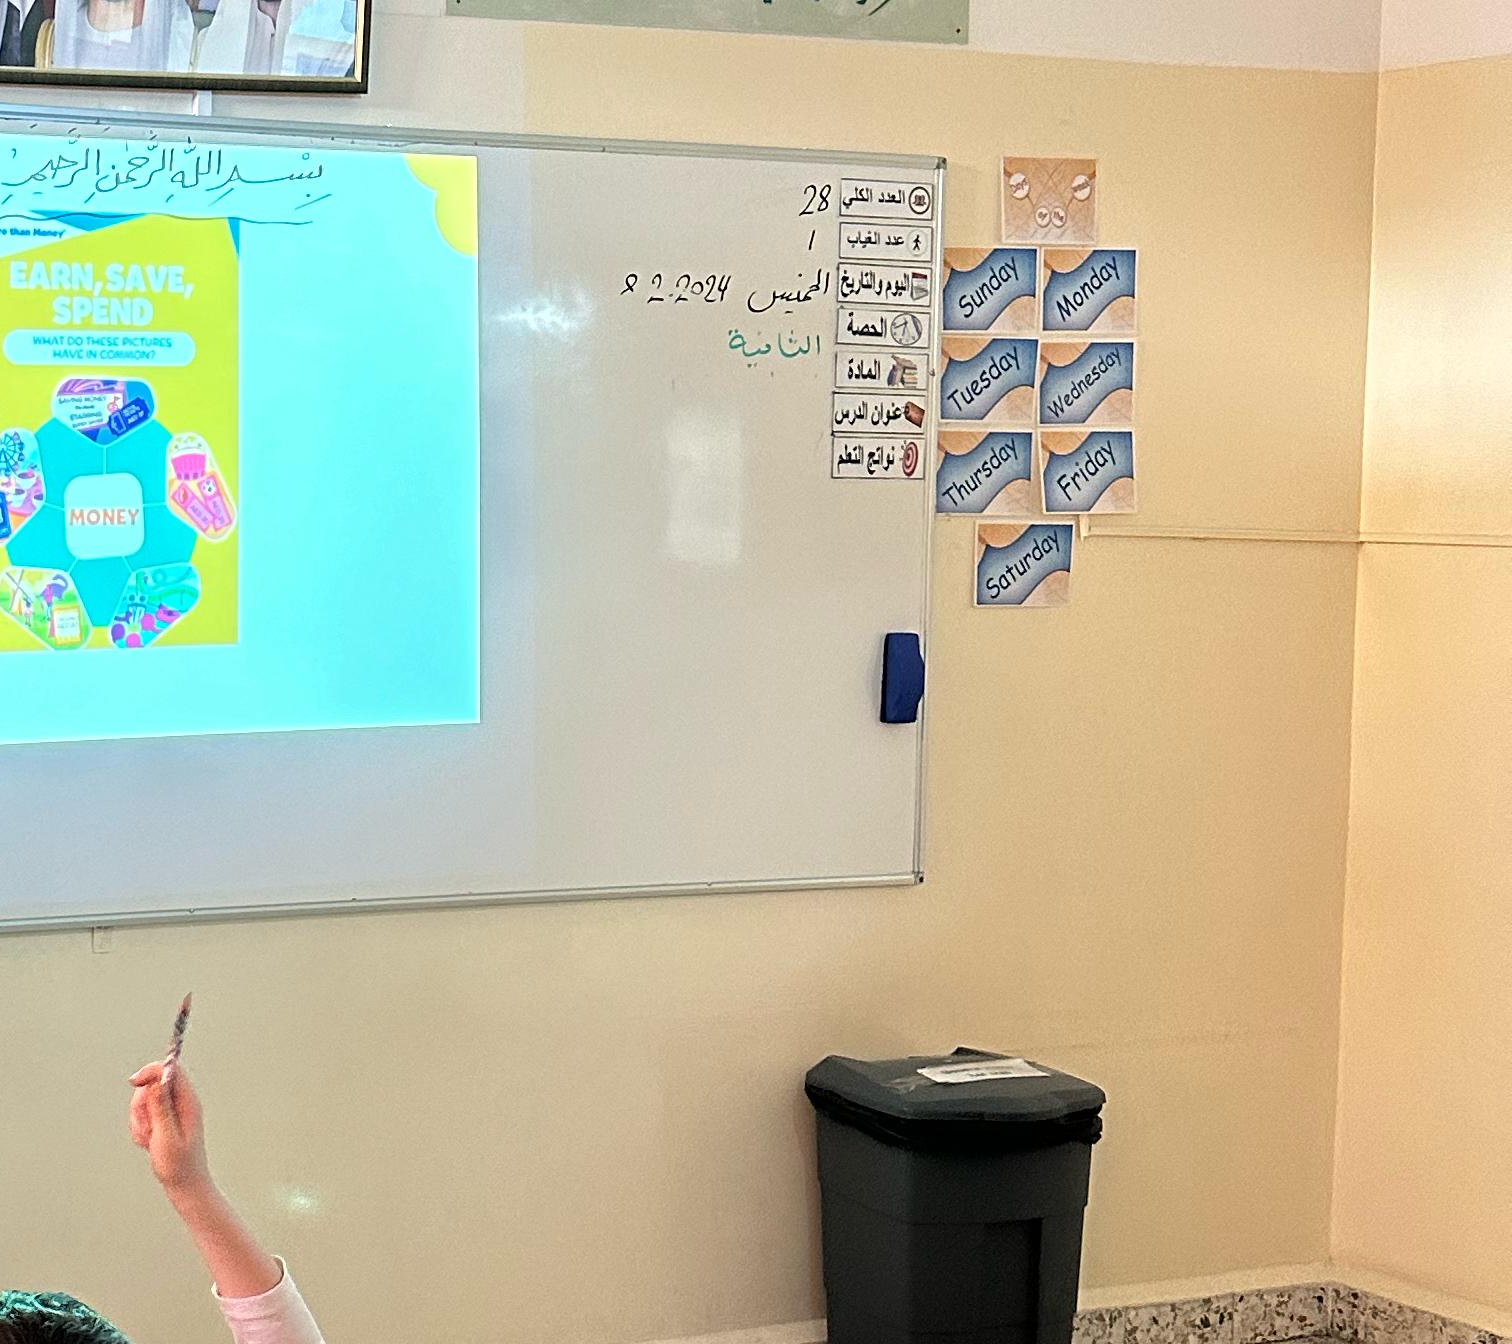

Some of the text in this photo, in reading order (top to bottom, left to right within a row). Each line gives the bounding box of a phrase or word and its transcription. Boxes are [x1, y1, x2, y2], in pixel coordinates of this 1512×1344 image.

[798, 184, 832, 216] 28
[842, 186, 906, 208] العدد الكلي
[10, 227, 31, 237] than
[847, 230, 905, 248] عدد الغياب
[9, 260, 196, 300] EARN, SAVE,
[840, 269, 911, 297] اليوم والتاريخ
[958, 256, 1019, 318] Sunday
[1056, 256, 1120, 322] Monday
[52, 295, 154, 326] SPEND
[847, 311, 887, 339] الحصة
[33, 336, 173, 347] WHAT DO THESE PICTURES
[53, 349, 156, 361] HAVE IN COMMON?
[847, 358, 881, 381] المادة
[947, 346, 1020, 411] Tuesday
[1047, 347, 1122, 418] Wednesday
[834, 401, 902, 426] عنوان الدرس
[838, 444, 896, 475] نواتج التعلم
[942, 437, 1018, 506] Thursday
[1056, 440, 1117, 501] Friday
[69, 508, 139, 527] MONEY
[986, 529, 1060, 599] Saturday
